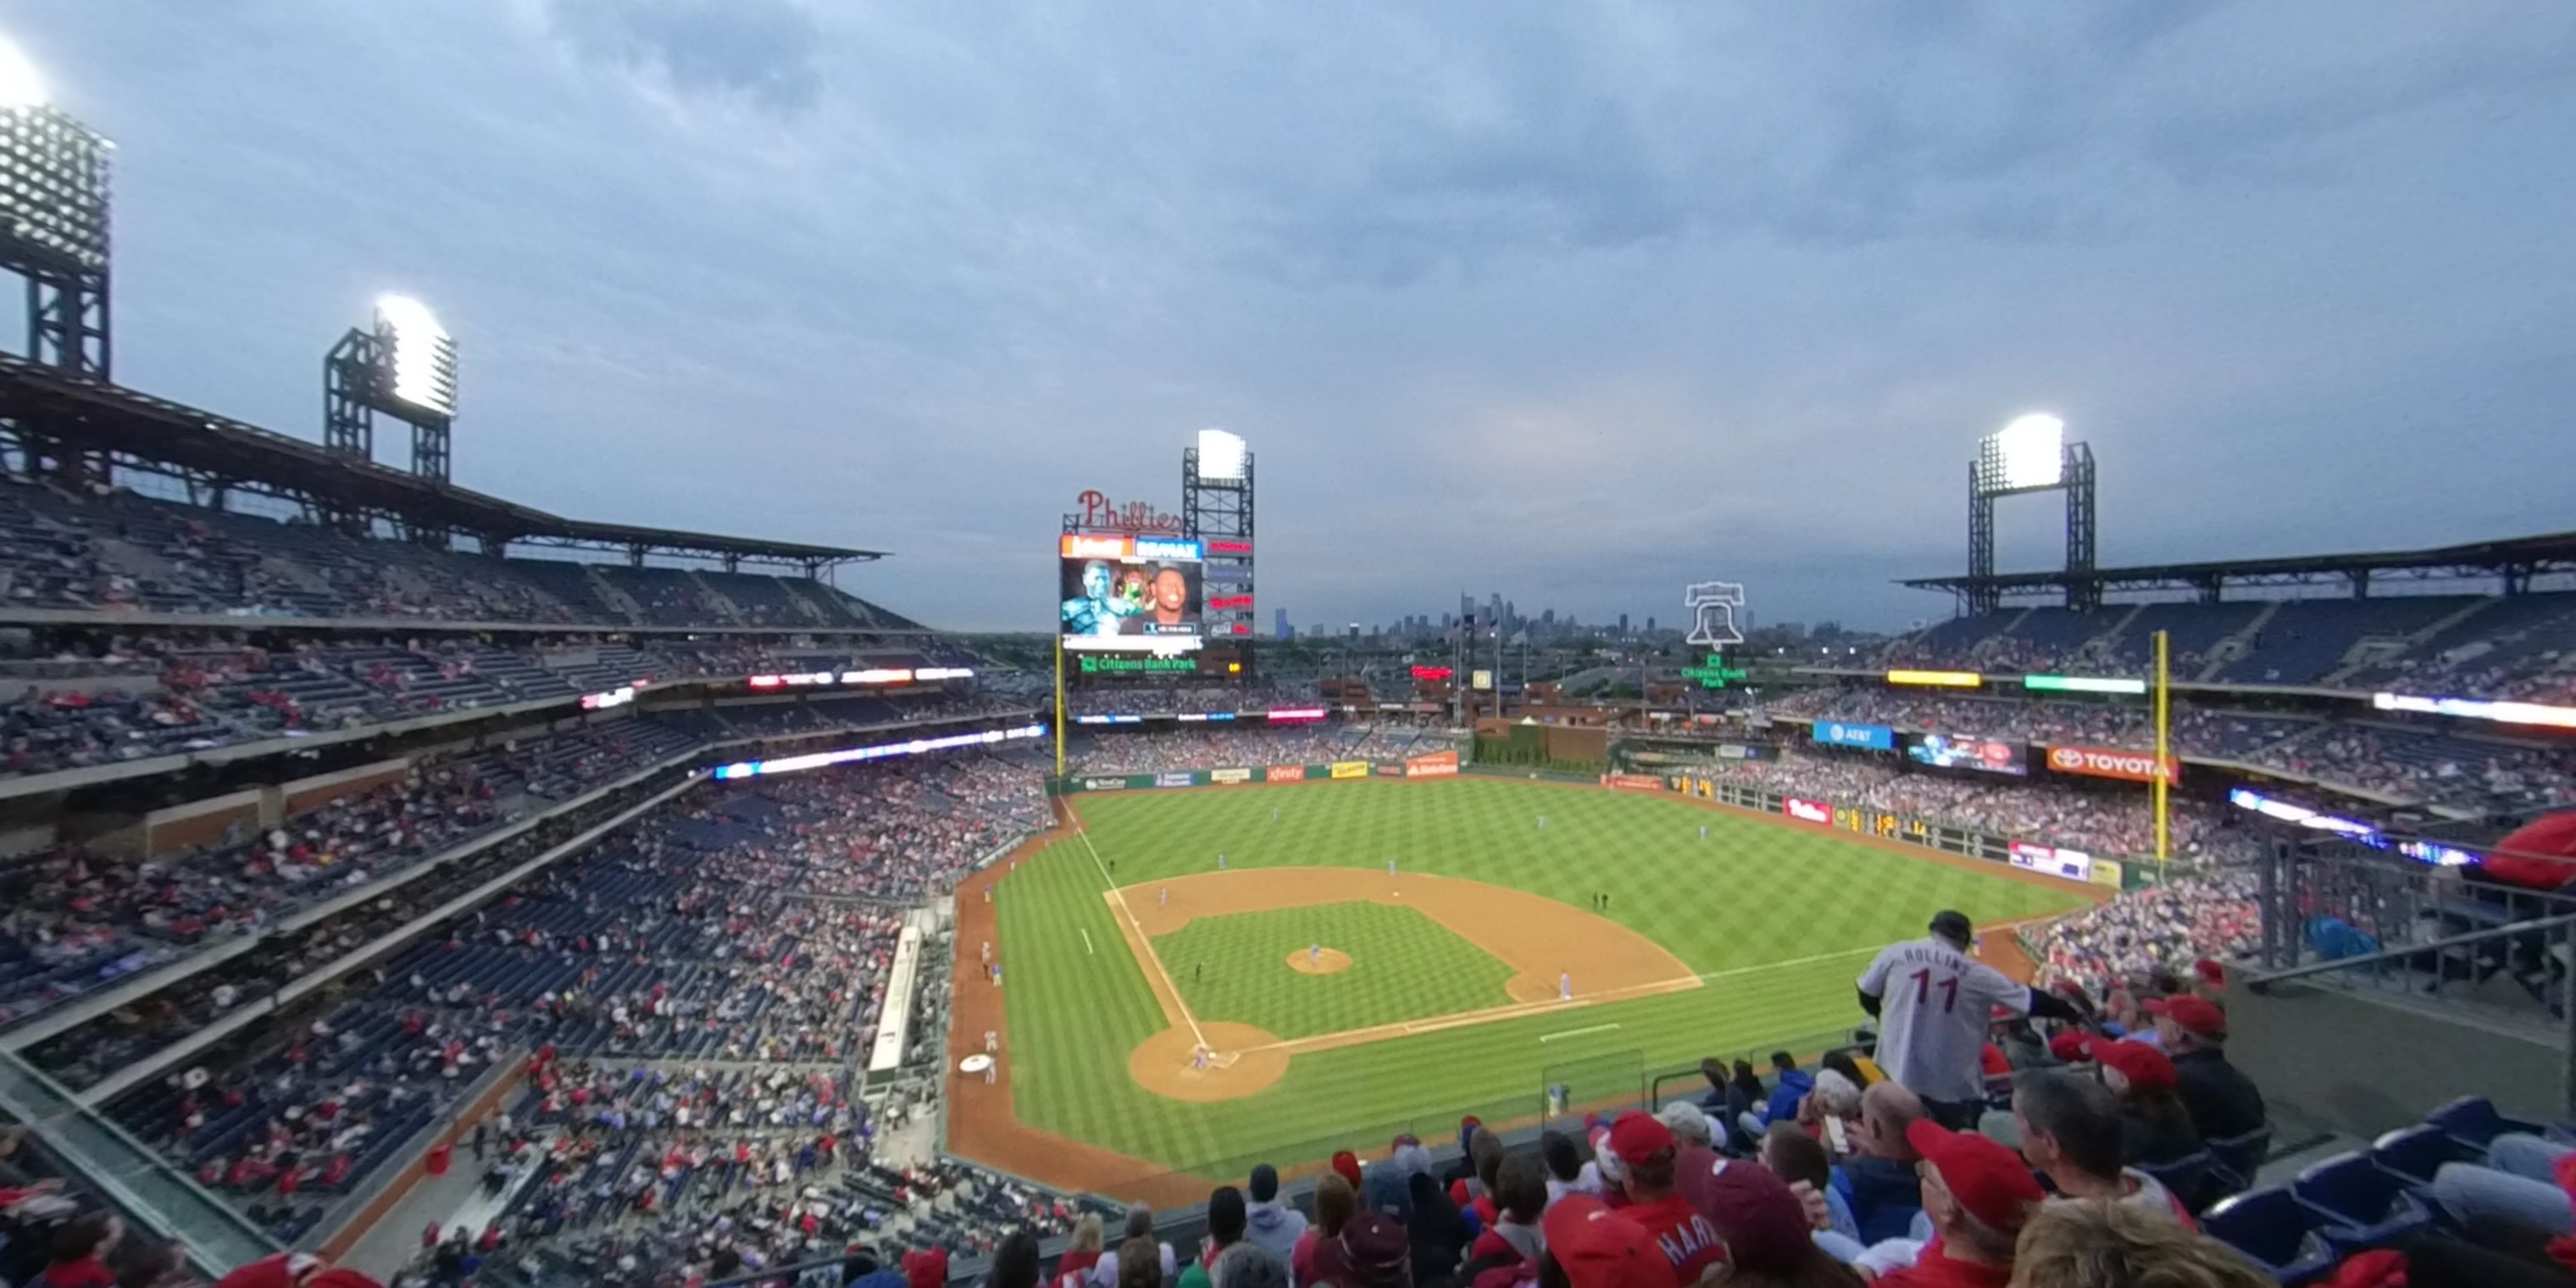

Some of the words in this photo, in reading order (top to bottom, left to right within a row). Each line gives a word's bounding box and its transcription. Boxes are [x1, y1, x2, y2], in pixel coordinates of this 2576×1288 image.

[1079, 490, 1183, 531] Phillies
[1099, 658, 1142, 669] Citizens
[1144, 658, 1171, 669] Bank
[1172, 658, 1196, 669] Park
[1680, 668, 1719, 679] Citizens
[1846, 729, 1871, 742] AT&T
[2084, 752, 2171, 778] TOYOTA
[1269, 768, 1302, 780] xfinity
[1910, 968, 1958, 1014] 11
